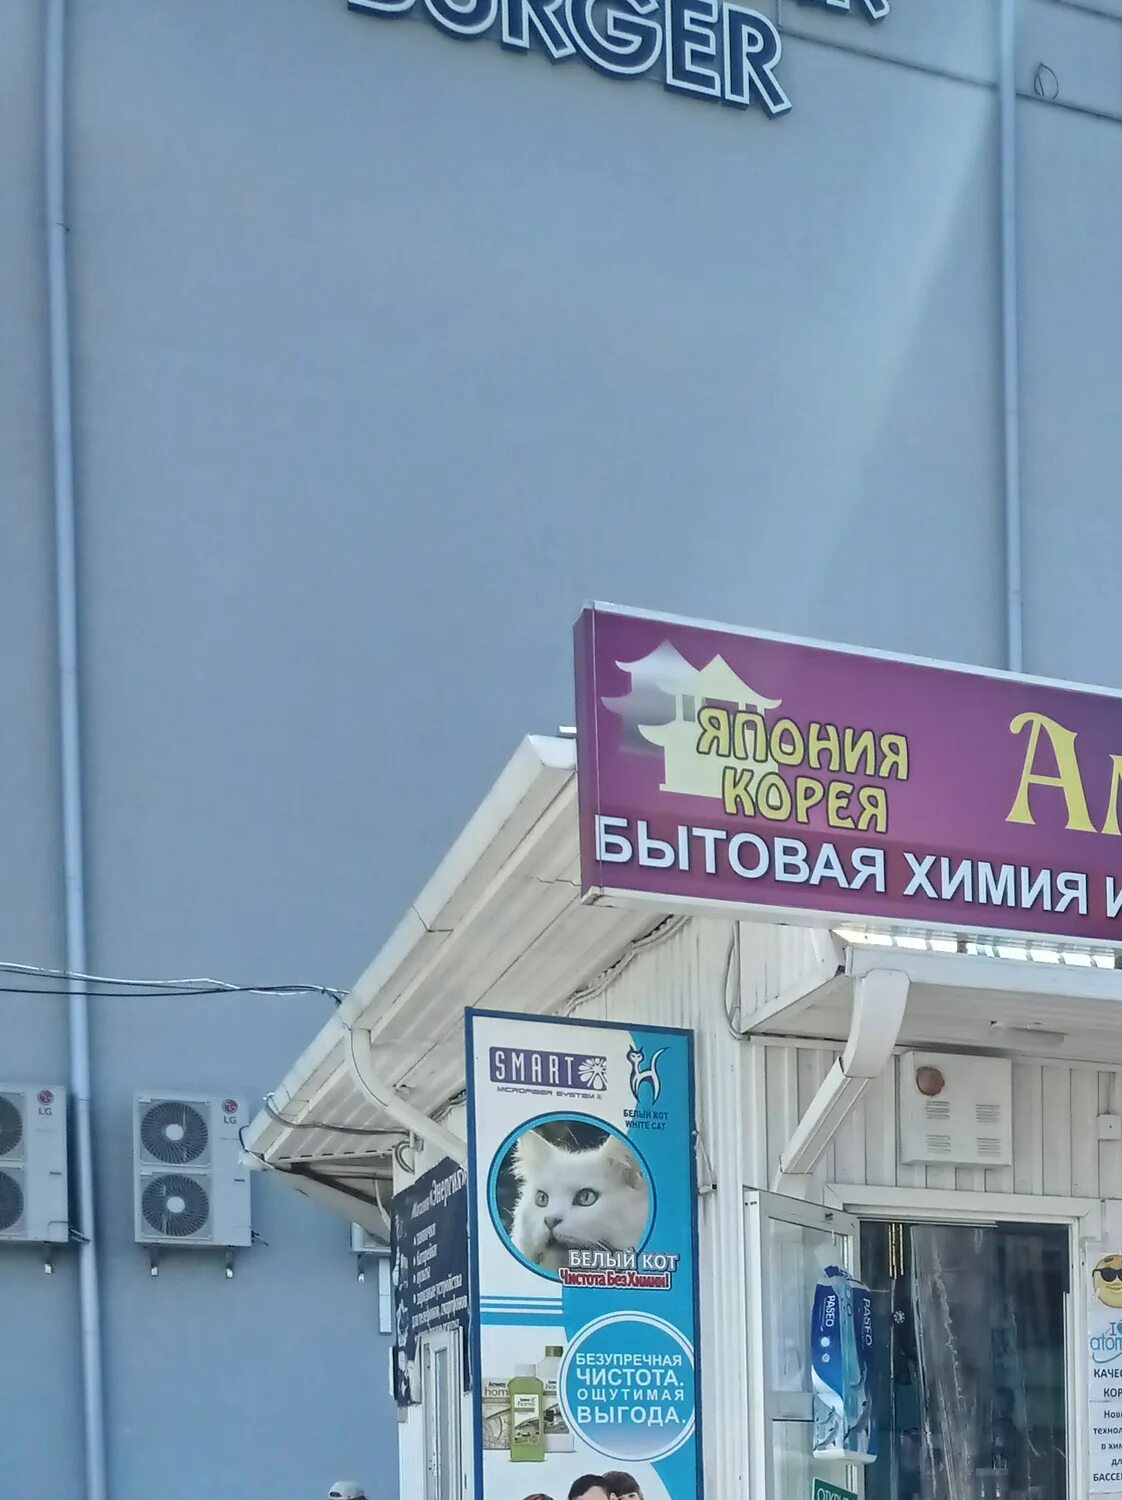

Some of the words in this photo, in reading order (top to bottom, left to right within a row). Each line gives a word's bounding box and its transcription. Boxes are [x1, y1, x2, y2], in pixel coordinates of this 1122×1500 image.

[697, 706, 910, 781] ЯПОНИЯ
[722, 767, 889, 834] КОРЕЯ
[594, 814, 887, 893] БЫТОВАЯ
[903, 851, 1088, 916] ХИМИЯ
[495, 1050, 575, 1085] SMART
[38, 1106, 52, 1116] LG
[223, 1115, 237, 1125] LG
[623, 1109, 651, 1119] БЕЛЫЙ
[653, 1111, 669, 1120] КОТ
[625, 1120, 650, 1130] WHITE
[651, 1122, 666, 1130] CAT
[570, 1248, 636, 1268] БЕЛЫЙ
[642, 1254, 678, 1270] КОТ
[560, 1269, 606, 1286] Чистота
[606, 1270, 628, 1287] Без
[825, 1295, 836, 1327] PASEO
[1109, 1322, 1117, 1336] I
[576, 1353, 682, 1366] БЕЗУПРЕЧНАЯ
[576, 1368, 684, 1386] ЧИСТОТА.
[577, 1388, 684, 1402] ОЩУТИМАЯ
[577, 1406, 686, 1427] ВЫГОДА.
[1101, 1442, 1107, 1450] в
